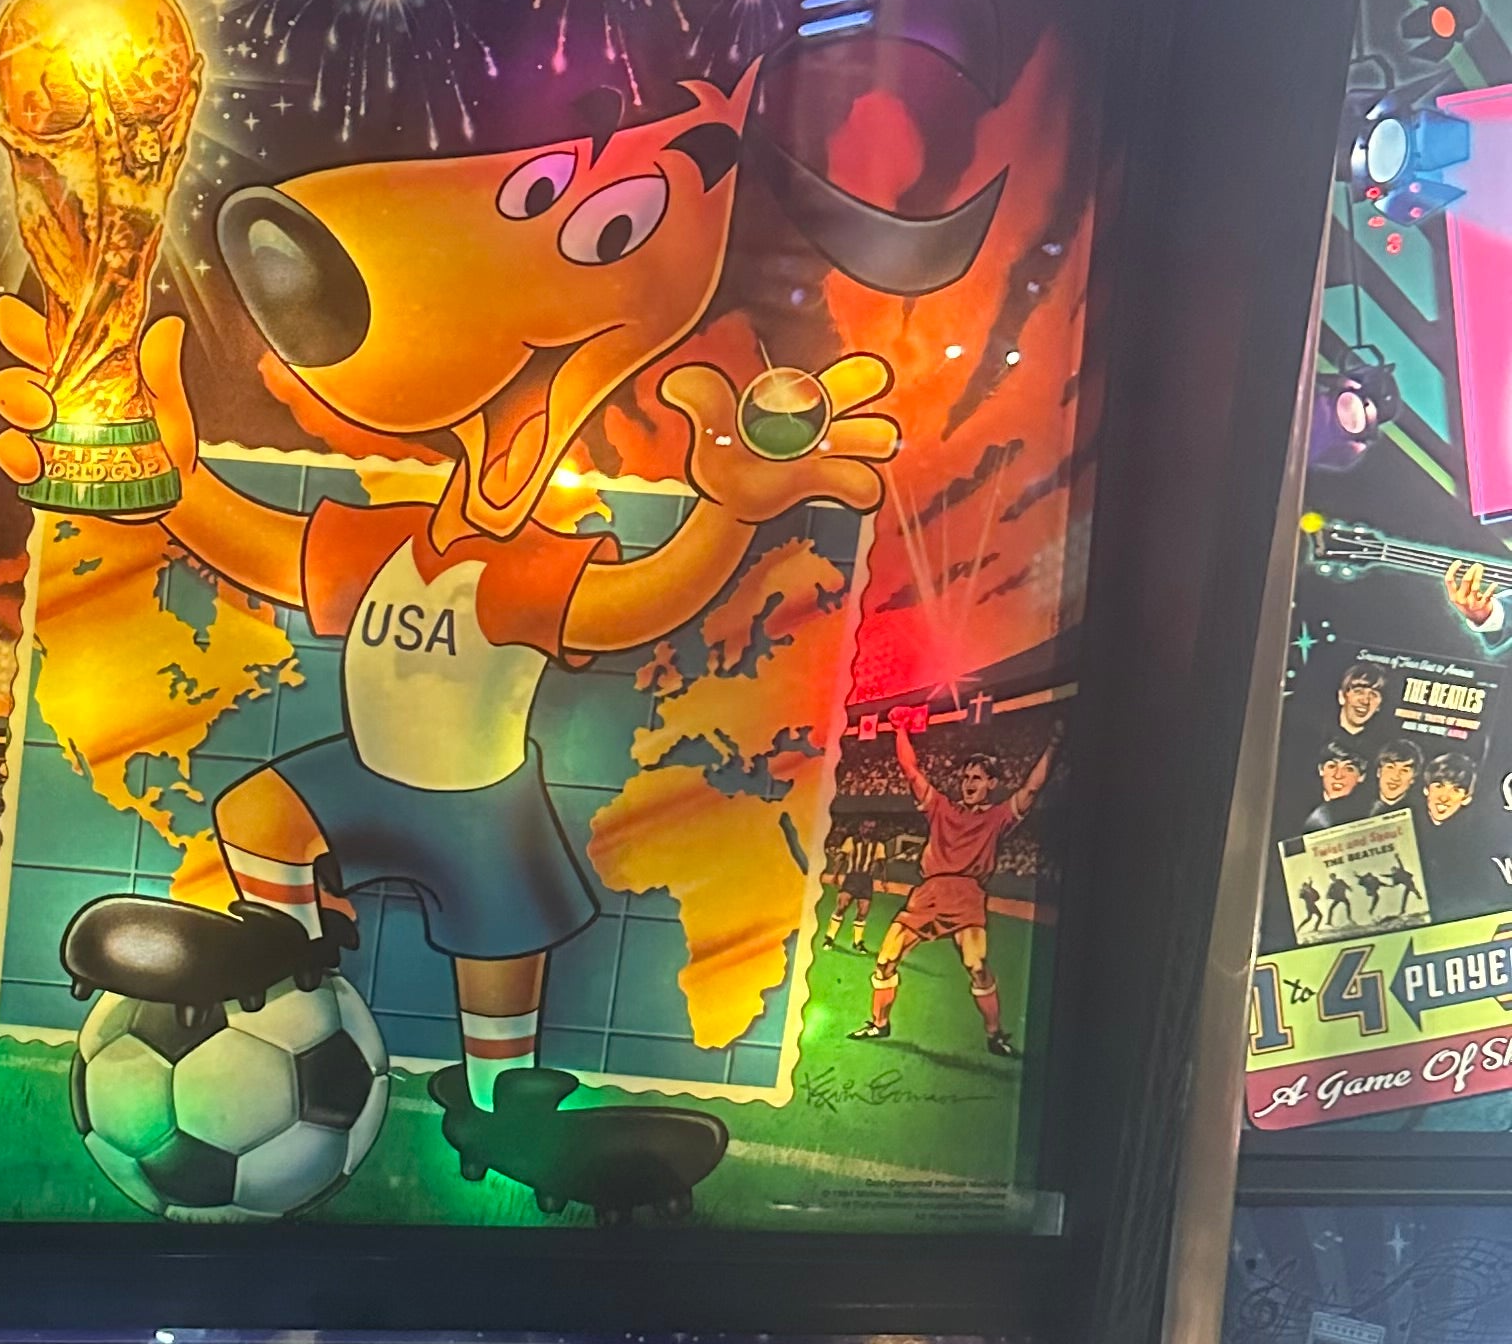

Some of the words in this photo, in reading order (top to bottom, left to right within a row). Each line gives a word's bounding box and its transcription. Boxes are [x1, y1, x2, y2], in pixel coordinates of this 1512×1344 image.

[52, 444, 137, 464] FIFA
[110, 459, 160, 480] CUP
[361, 600, 457, 656] USA
[1402, 677, 1432, 705] THE
[1428, 681, 1486, 714] BEATLES
[1311, 842, 1345, 858] Twist
[1345, 834, 1368, 849] and
[1368, 825, 1405, 844] Shout
[1322, 856, 1345, 868] THE
[1347, 843, 1395, 862] BEATLES
[1250, 962, 1294, 1055] 1
[1284, 978, 1316, 1004] to
[1316, 944, 1388, 1037] 4
[1404, 946, 1512, 1003] PLAYE
[1254, 1076, 1308, 1119] A
[1316, 1068, 1412, 1110] Game
[1422, 1042, 1478, 1093] Of
